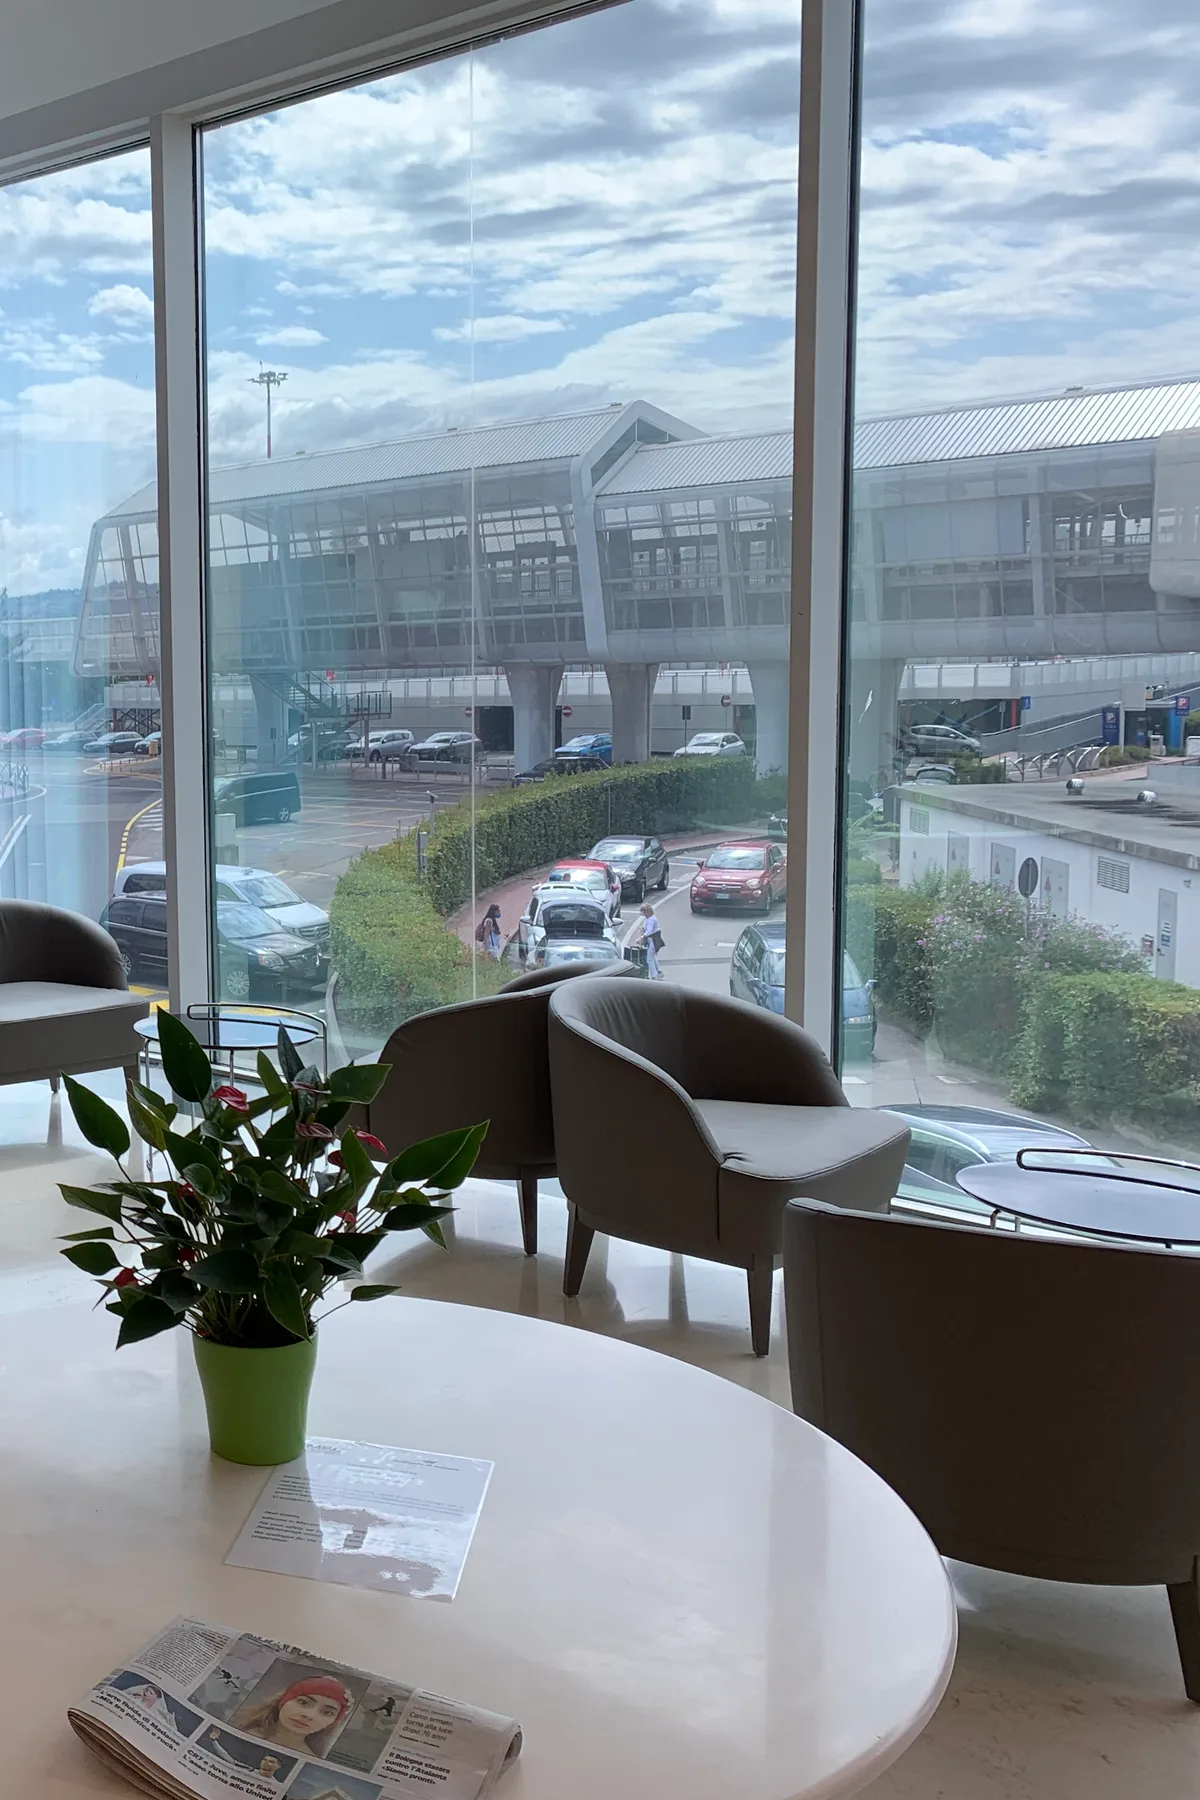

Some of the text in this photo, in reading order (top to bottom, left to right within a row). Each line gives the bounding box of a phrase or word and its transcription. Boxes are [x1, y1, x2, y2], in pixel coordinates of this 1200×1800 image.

[100, 1690, 122, 1703] L'arte
[121, 1700, 142, 1718] fluida
[142, 1715, 150, 1724] di
[150, 1721, 181, 1747] Madame
[114, 1703, 125, 1713] tra
[125, 1711, 151, 1733] pizzica
[406, 1719, 454, 1735] torna alla luce
[409, 1711, 428, 1721] Carro
[428, 1716, 454, 1727] armato
[402, 1725, 421, 1736] dopo
[431, 1733, 447, 1741] anni
[187, 1749, 203, 1762] CR7
[209, 1763, 229, 1778] Juve,
[230, 1775, 256, 1788] amore
[255, 1783, 277, 1796] finito
[385, 1759, 410, 1770] contro
[411, 1765, 448, 1781] l'Atalanta
[395, 1753, 424, 1767] Bologna
[424, 1762, 451, 1774] stasera
[183, 1754, 207, 1772] L'asso
[207, 1770, 229, 1785] torna
[229, 1781, 244, 1792] allo
[245, 1787, 274, 1800] United
